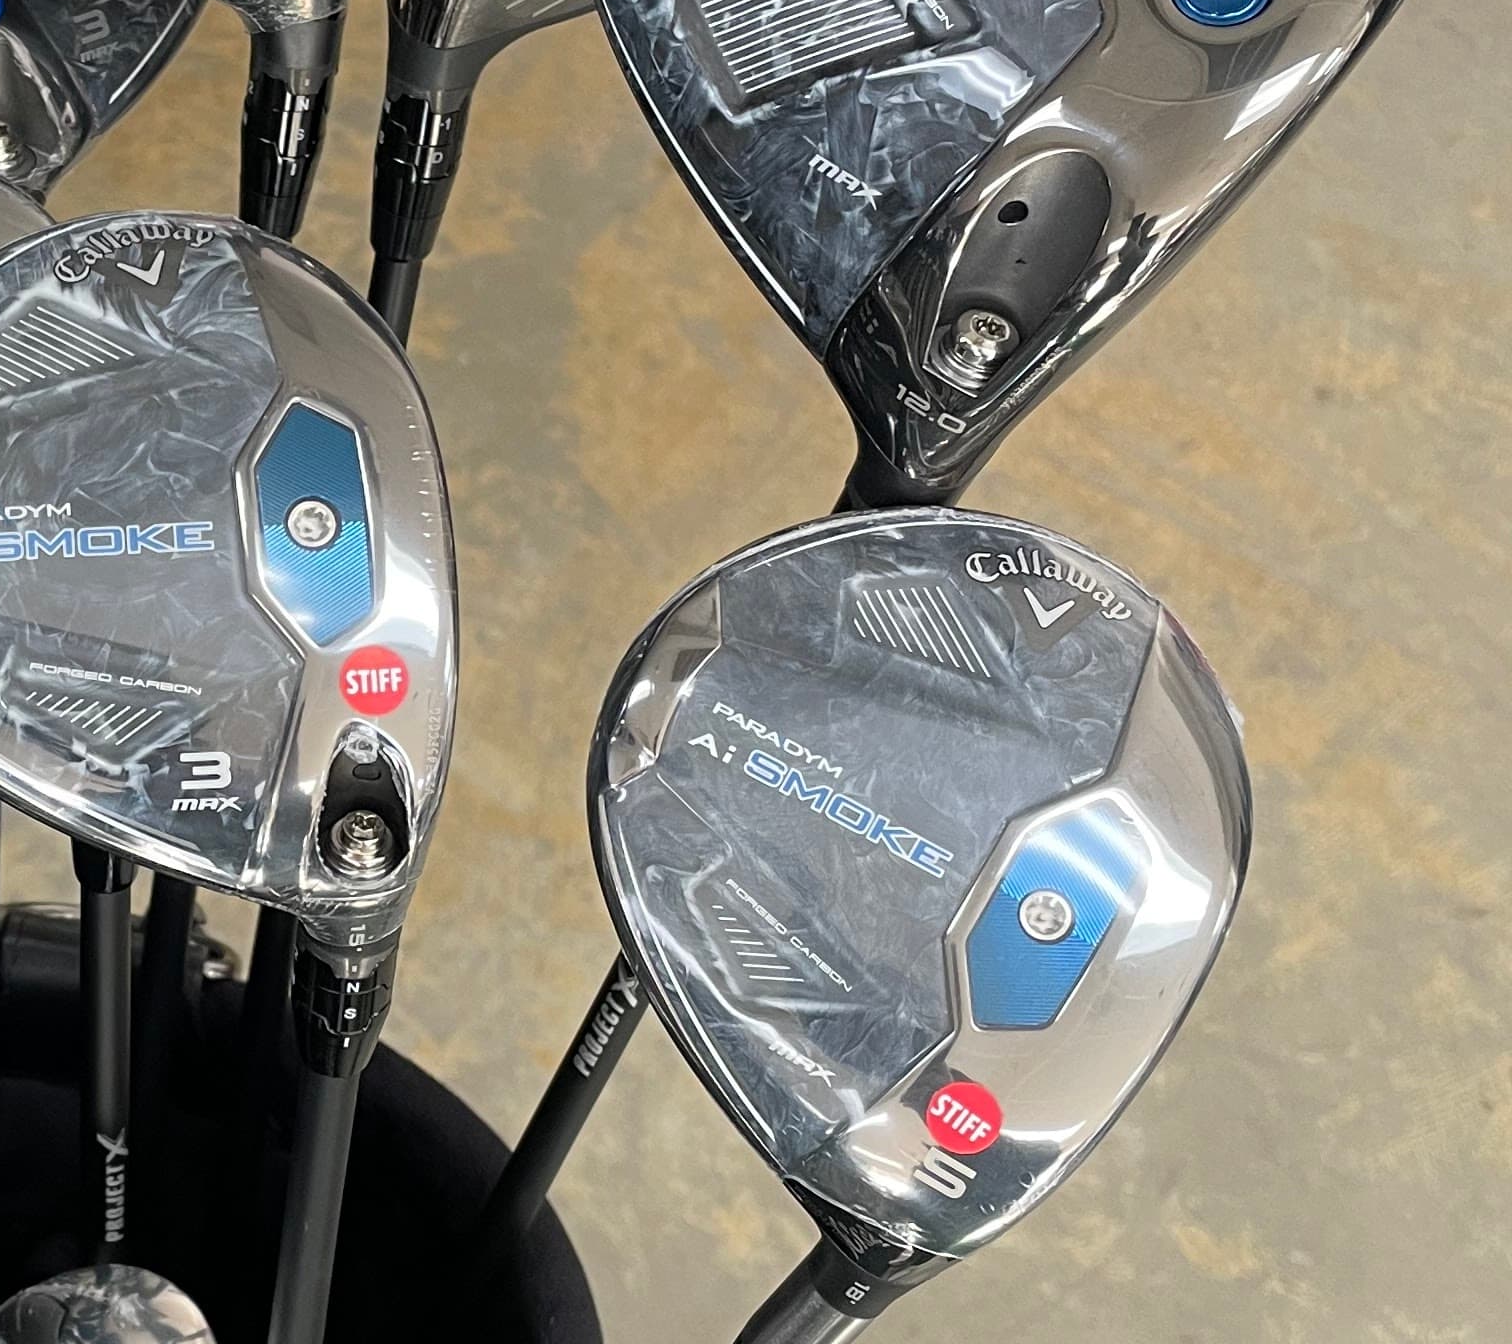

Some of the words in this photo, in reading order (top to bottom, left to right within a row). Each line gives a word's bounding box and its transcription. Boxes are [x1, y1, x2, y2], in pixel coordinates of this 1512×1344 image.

[73, 7, 113, 43] 3
[808, 153, 882, 211] MAX
[53, 223, 216, 285] Callaway
[895, 383, 967, 434] 12.0
[964, 546, 1133, 622] Callaway
[29, 662, 112, 683] FORGED
[119, 674, 202, 697] CARBON
[346, 668, 403, 694] STIFF
[712, 701, 844, 779] PARADYM
[179, 751, 232, 791] 3
[171, 796, 244, 812] MAX
[688, 731, 737, 766] Ai
[743, 748, 955, 879] SMOKE
[725, 878, 789, 937] FORGED
[789, 935, 853, 993] CARBON
[573, 991, 625, 1078] PROJECT
[611, 958, 639, 1008] X
[96, 1128, 129, 1162] X
[928, 1092, 994, 1145] STIFF
[912, 1145, 978, 1200] 5
[104, 1163, 126, 1242] PROJECT
